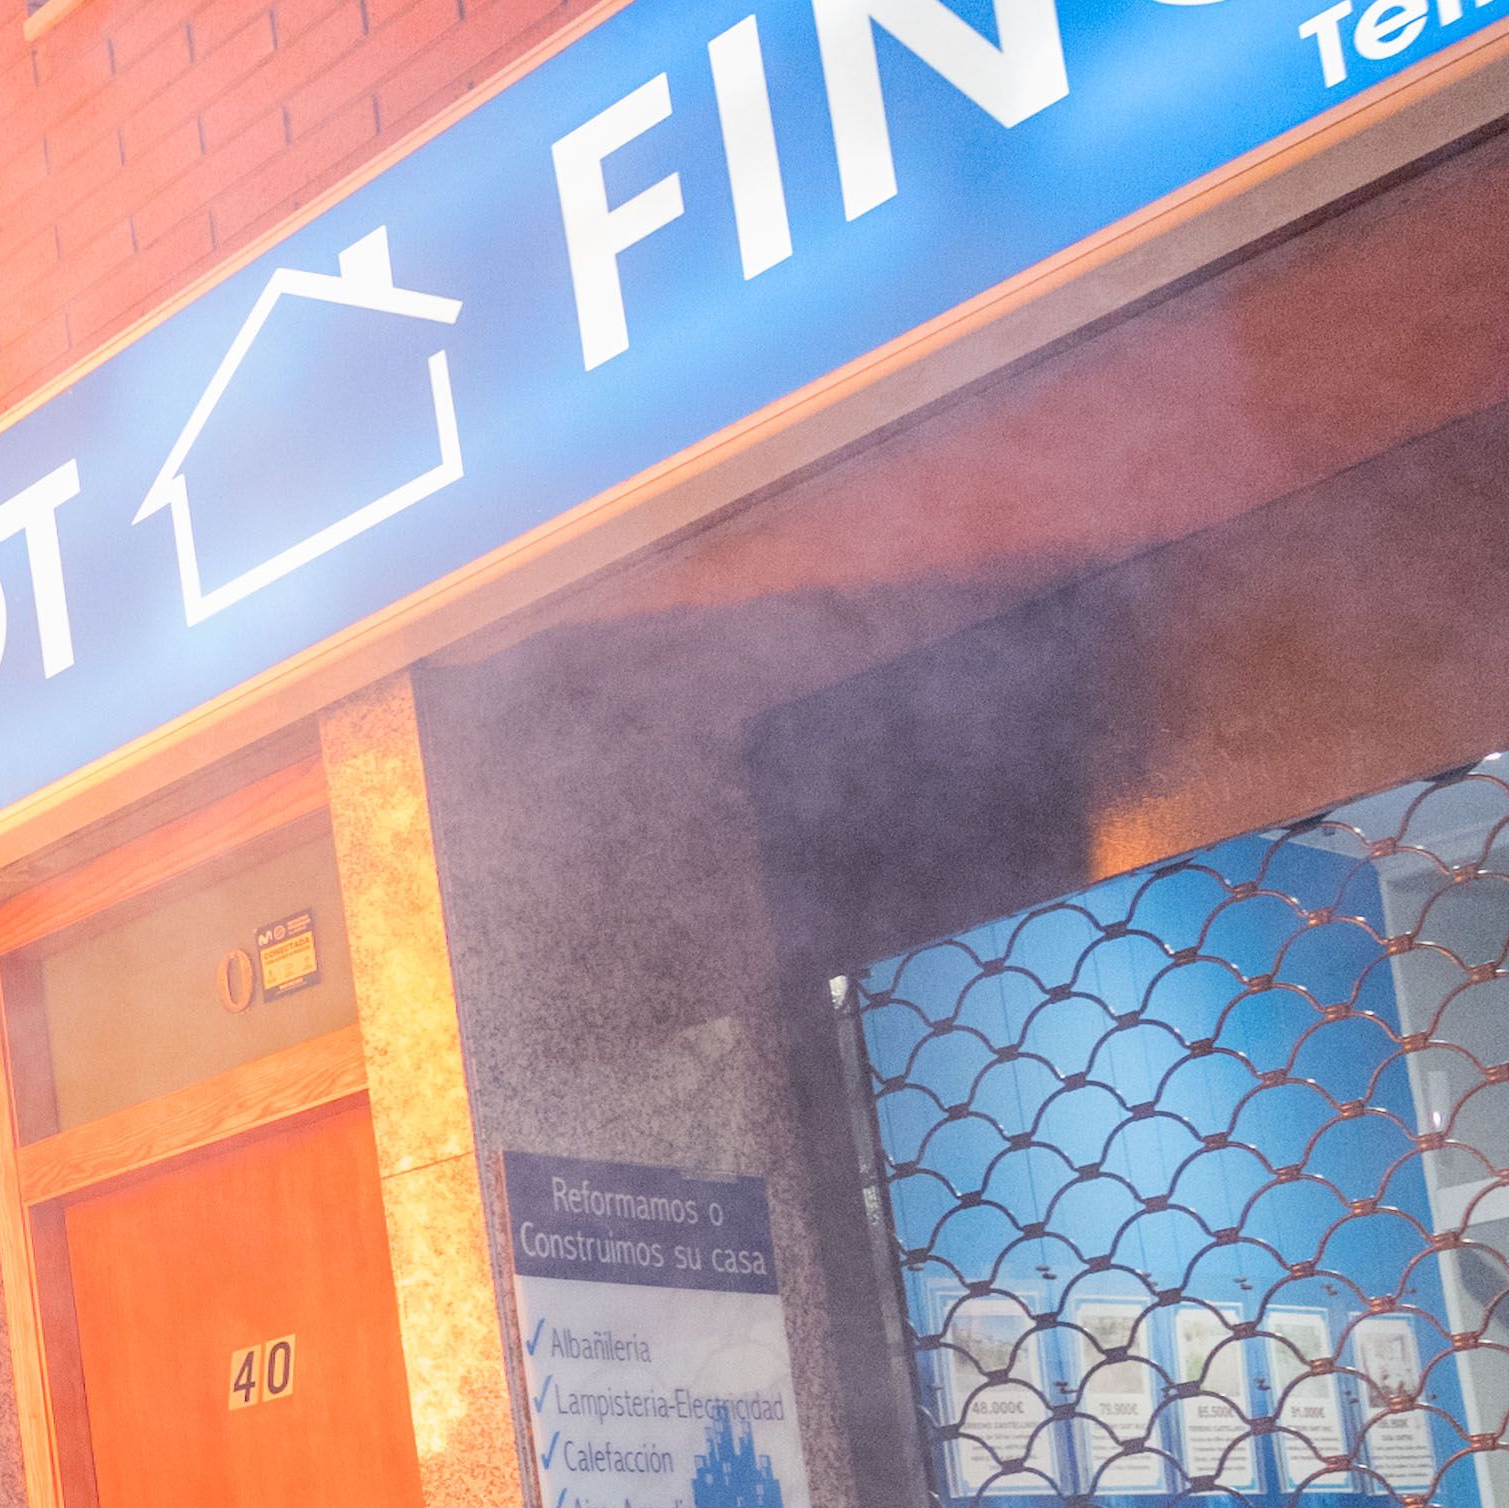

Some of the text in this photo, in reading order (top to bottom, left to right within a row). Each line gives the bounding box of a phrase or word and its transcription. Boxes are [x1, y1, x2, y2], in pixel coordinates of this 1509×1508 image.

[551, 1176, 724, 1226] Reformamos o
[520, 1221, 768, 1276] Construimos su casa
[233, 1341, 291, 1403] 40
[563, 1441, 674, 1475] Calefacción
